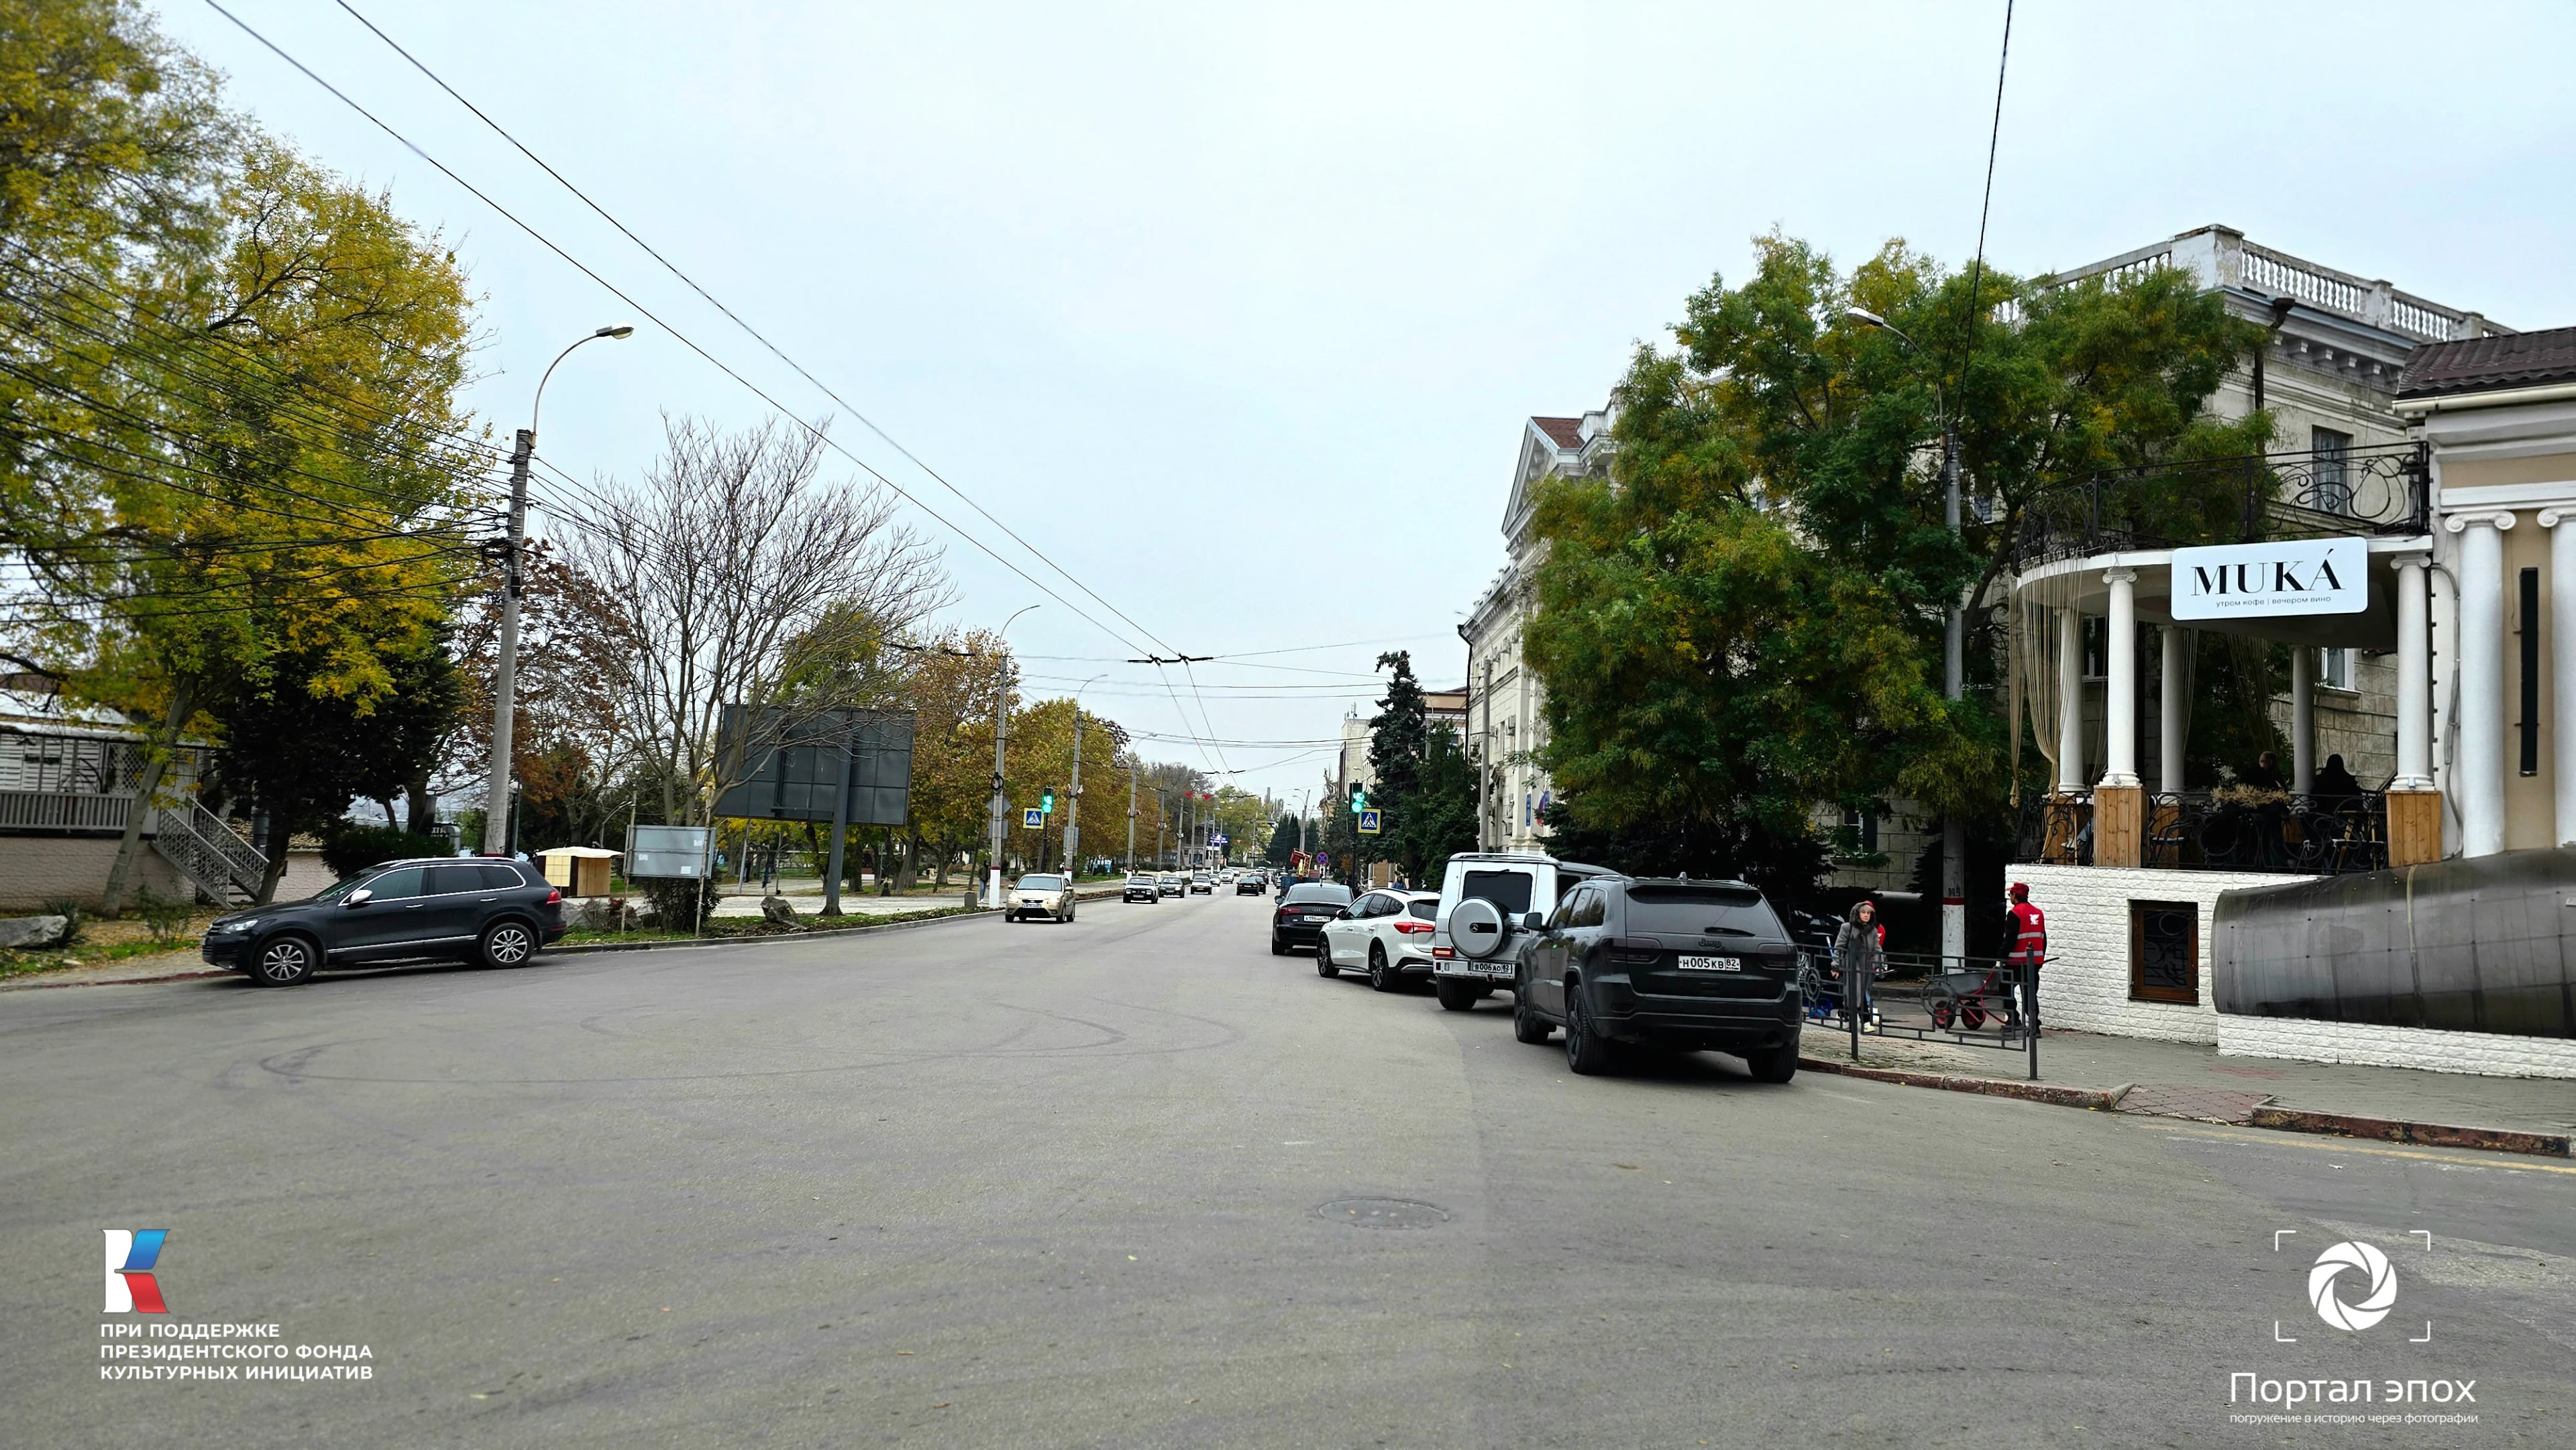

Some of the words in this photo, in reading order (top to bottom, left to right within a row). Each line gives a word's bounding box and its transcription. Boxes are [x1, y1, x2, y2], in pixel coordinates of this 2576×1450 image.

[2215, 600, 2241, 608] утром
[2243, 599, 2265, 608] кофе
[2272, 596, 2308, 606] вечером
[2310, 595, 2331, 604] вино
[1698, 938, 1722, 948] Jeep
